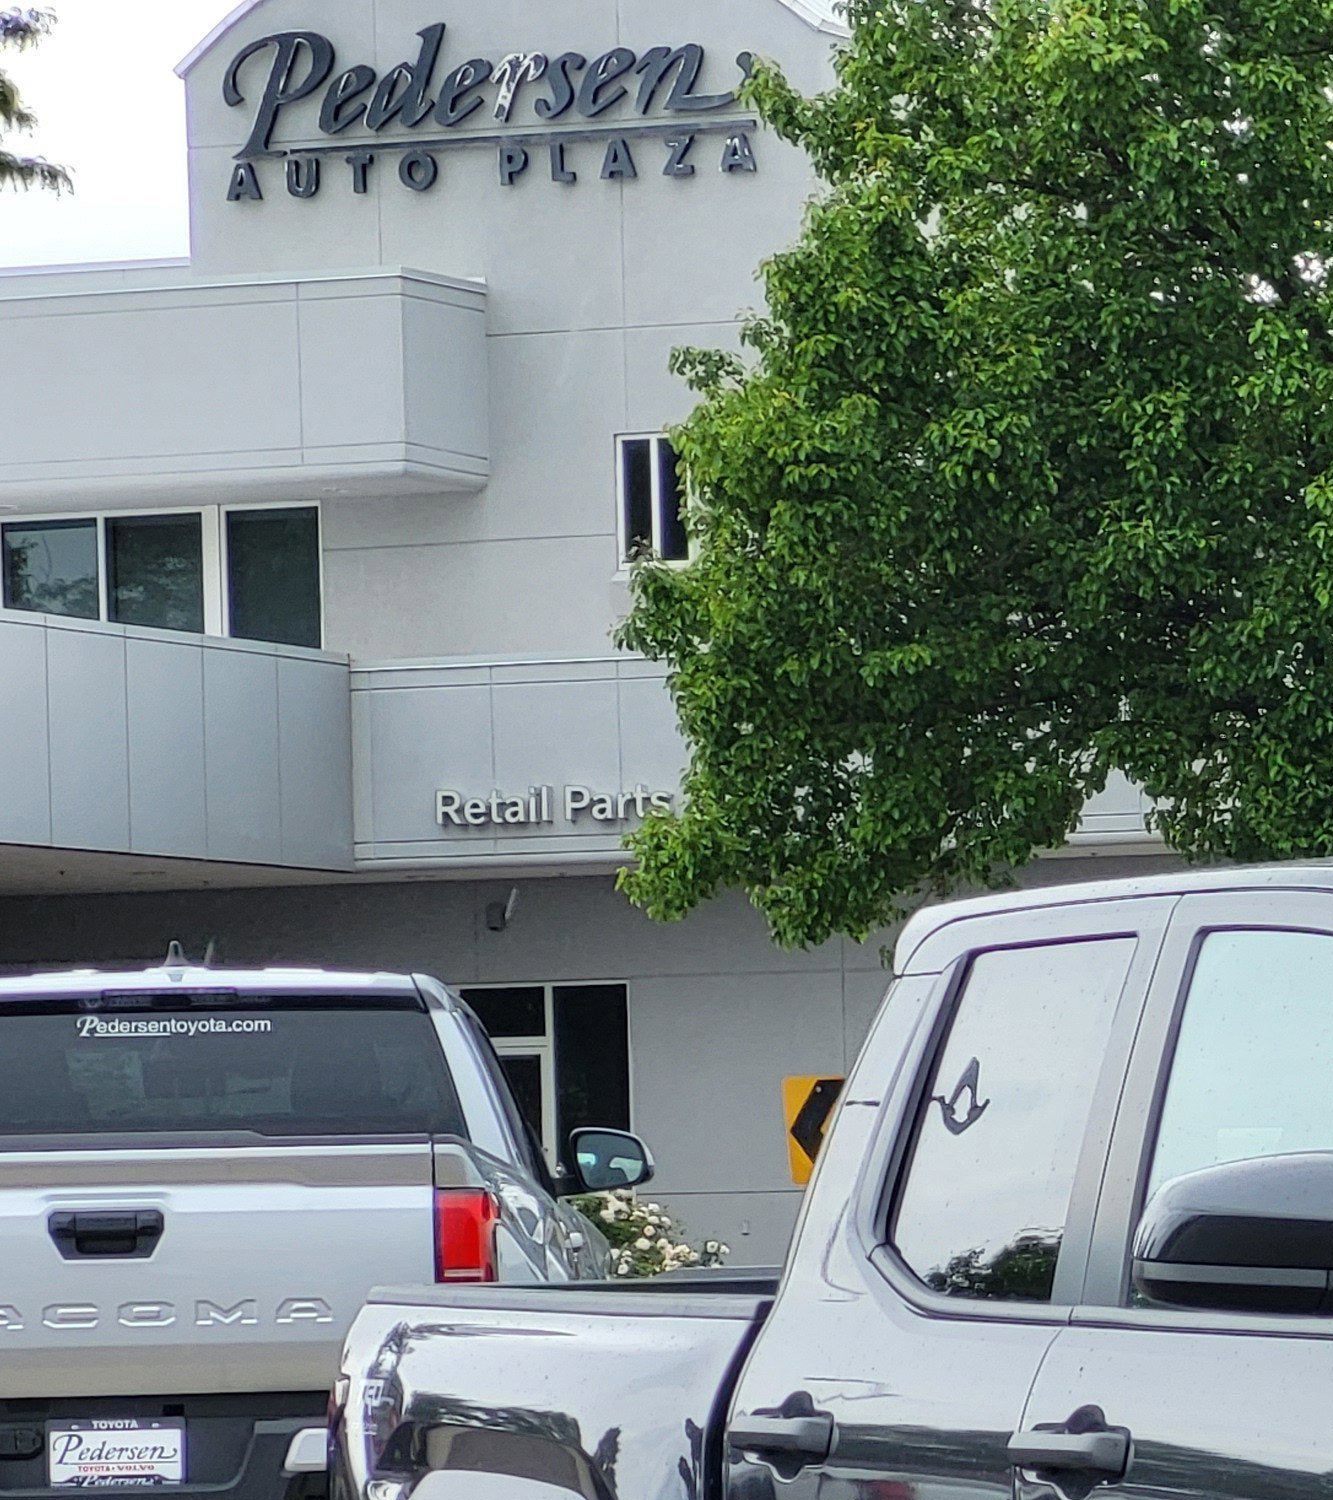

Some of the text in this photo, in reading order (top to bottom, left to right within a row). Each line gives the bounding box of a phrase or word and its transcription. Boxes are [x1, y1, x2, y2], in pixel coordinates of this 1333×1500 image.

[222, 22, 756, 160] Pedersen
[226, 132, 757, 200] AUTO PLAZA
[435, 783, 673, 826] Retail Parts
[76, 1015, 272, 1037] Pedersentoyota.com
[91, 1418, 139, 1429] TOYOTA
[53, 1433, 178, 1465] Pedersen
